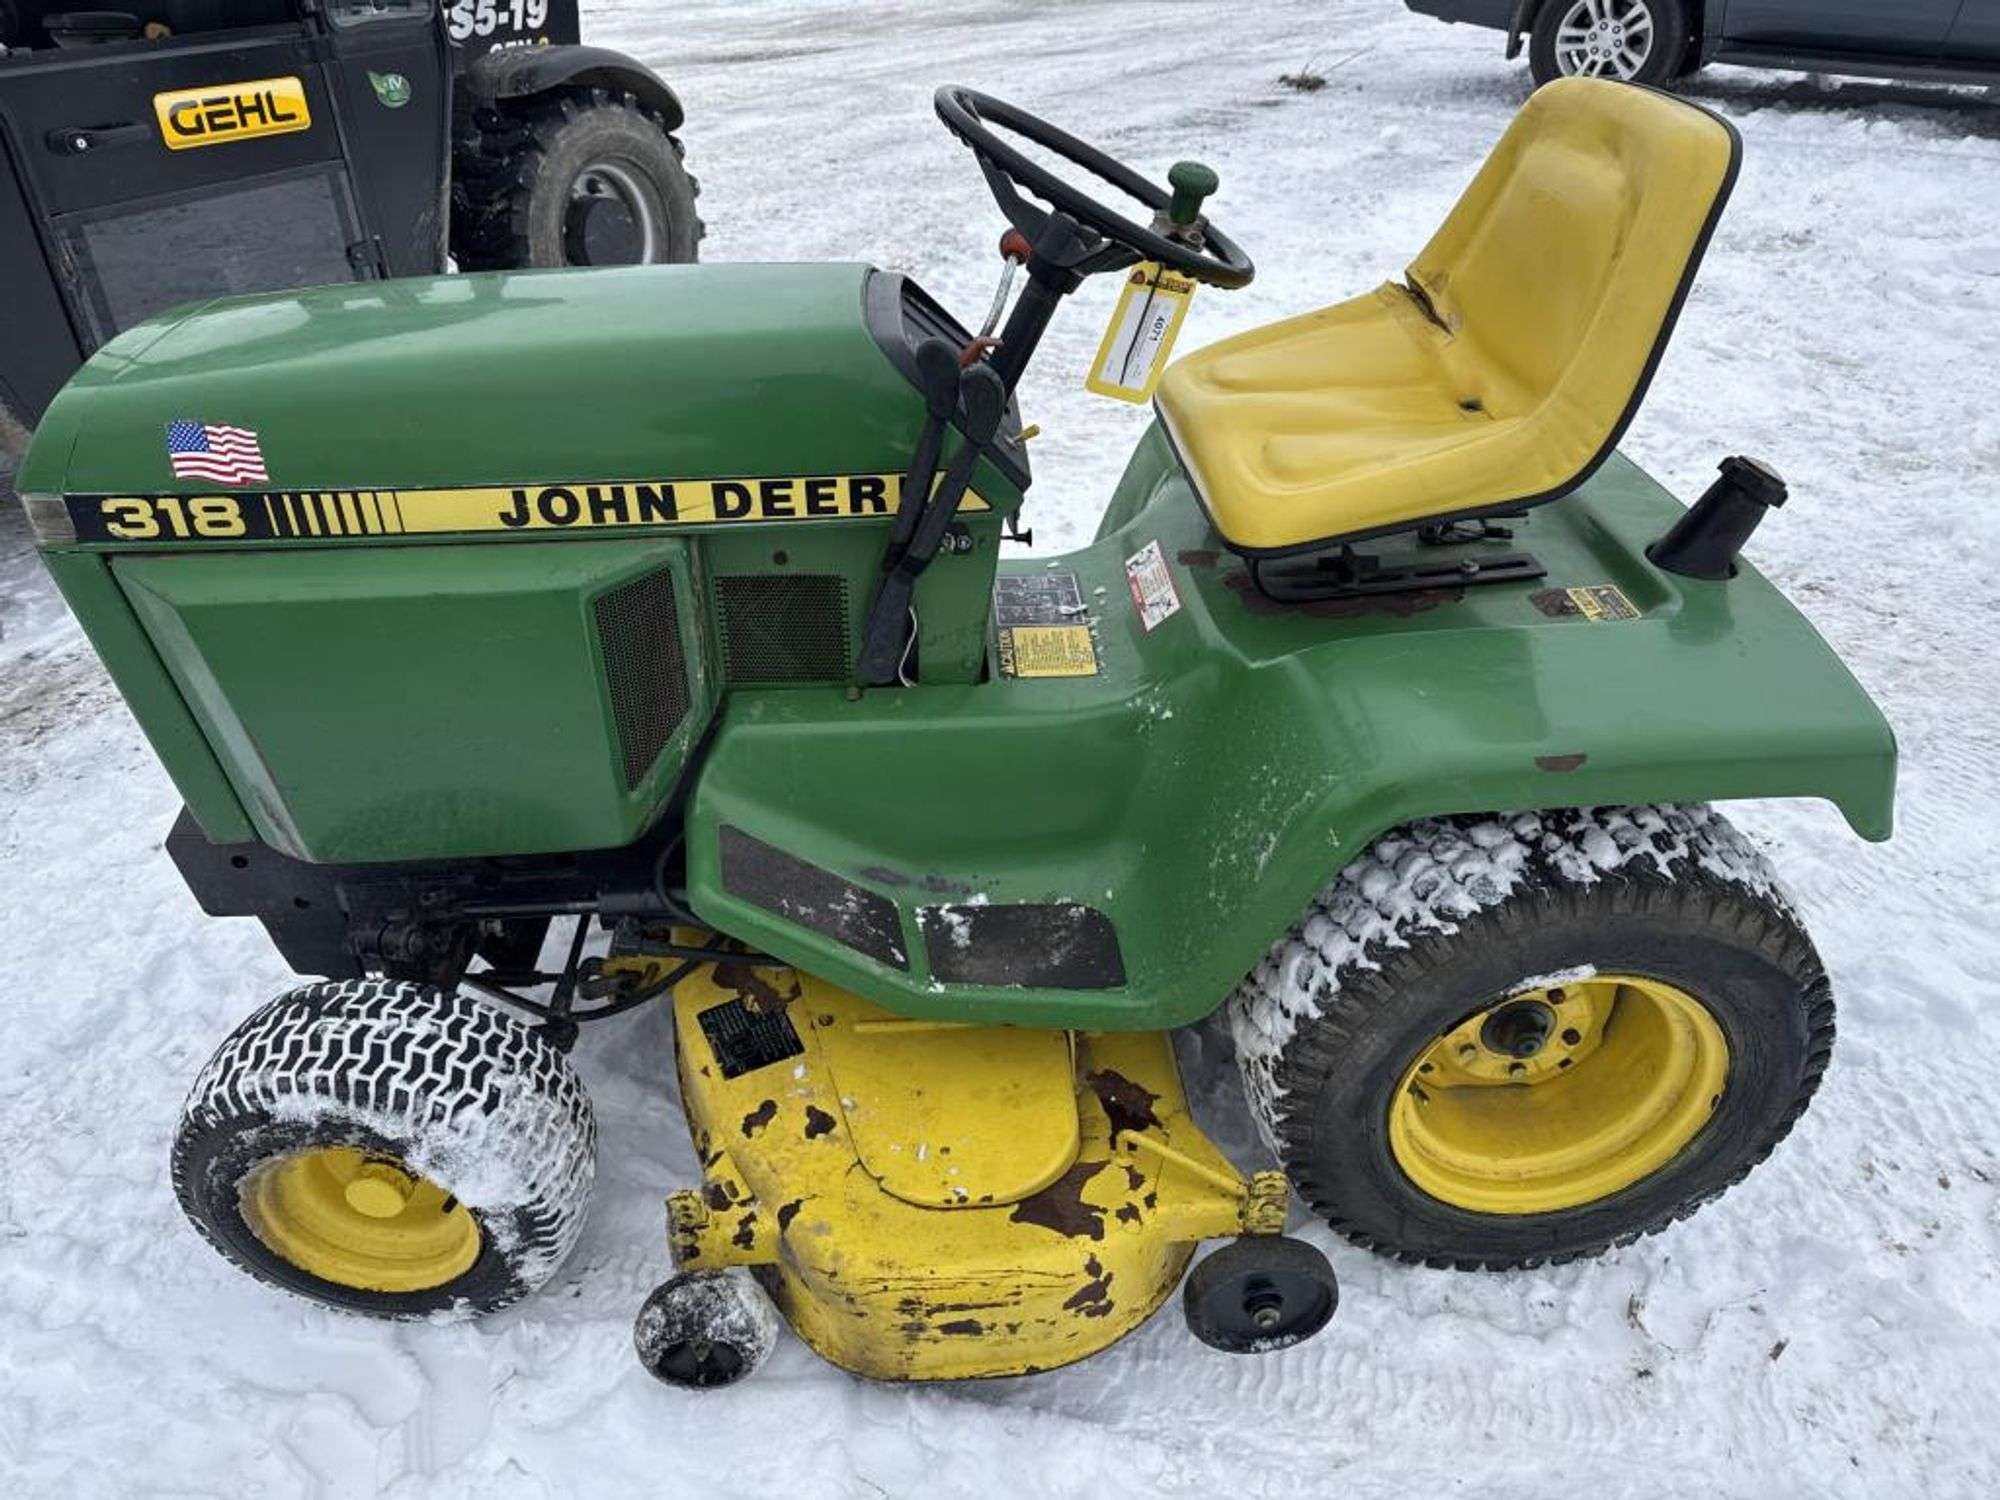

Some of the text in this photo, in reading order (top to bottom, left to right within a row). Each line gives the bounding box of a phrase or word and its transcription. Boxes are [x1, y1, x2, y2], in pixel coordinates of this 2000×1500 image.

[169, 91, 297, 136] GEHL
[101, 497, 246, 538] 318
[499, 476, 906, 527] JOHN DEER
